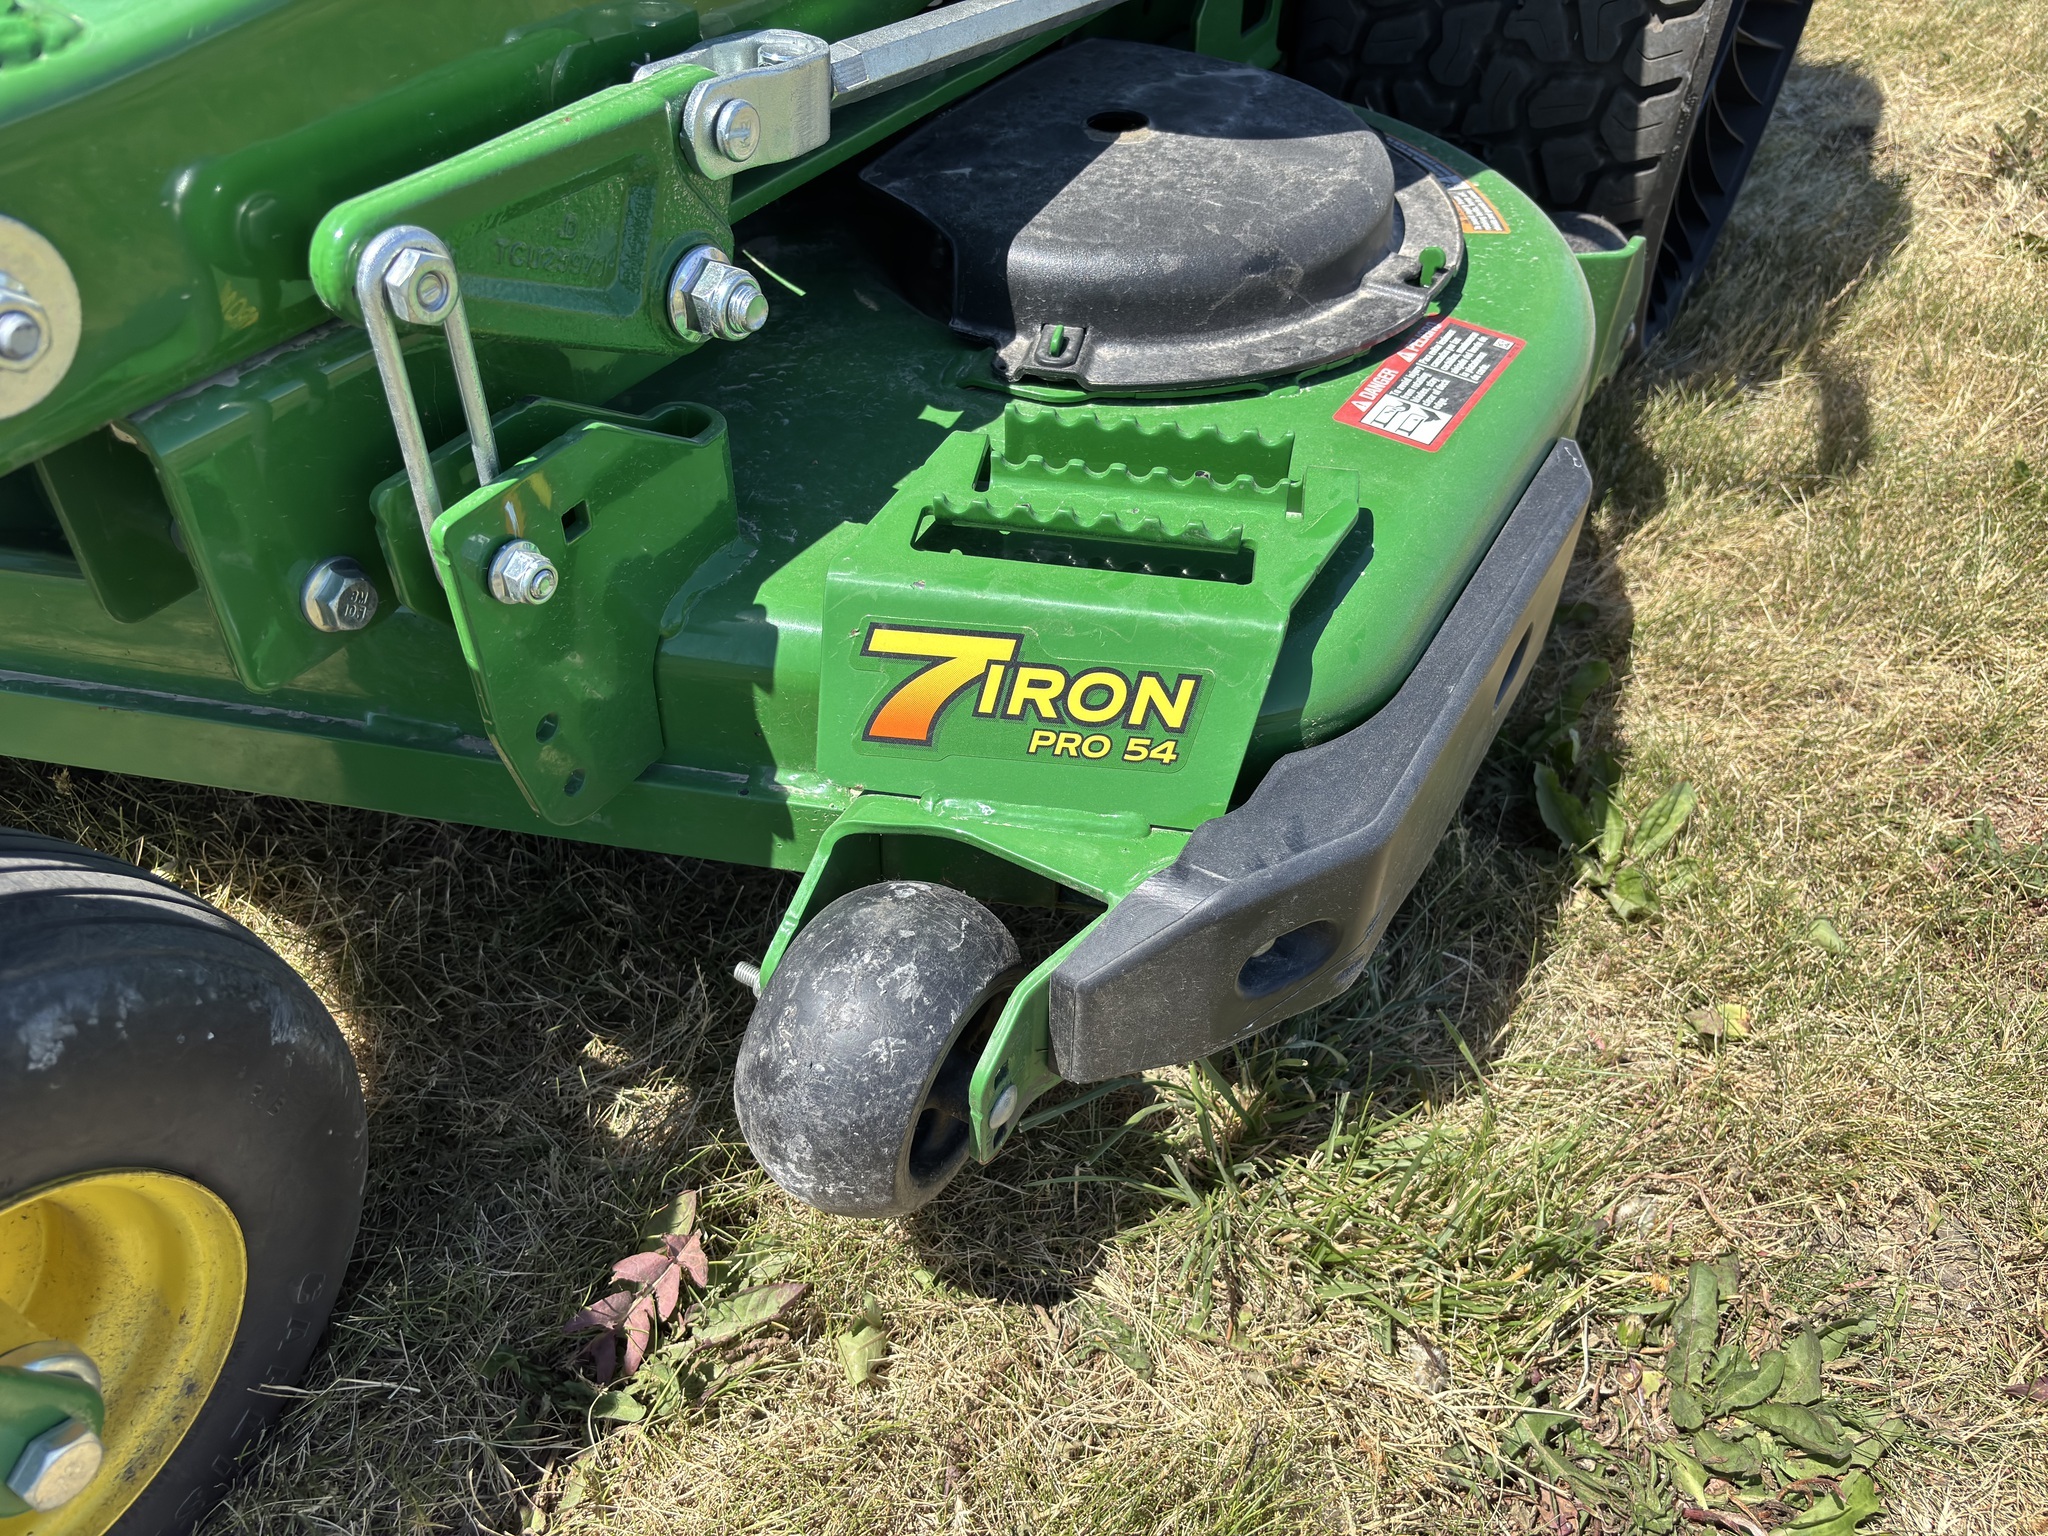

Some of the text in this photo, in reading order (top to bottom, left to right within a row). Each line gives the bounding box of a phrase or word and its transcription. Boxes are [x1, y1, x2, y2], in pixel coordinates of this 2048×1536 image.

[1358, 367, 1399, 400] DANGER
[860, 622, 1203, 748] 7 IRON
[1026, 729, 1180, 767] PRO 54
